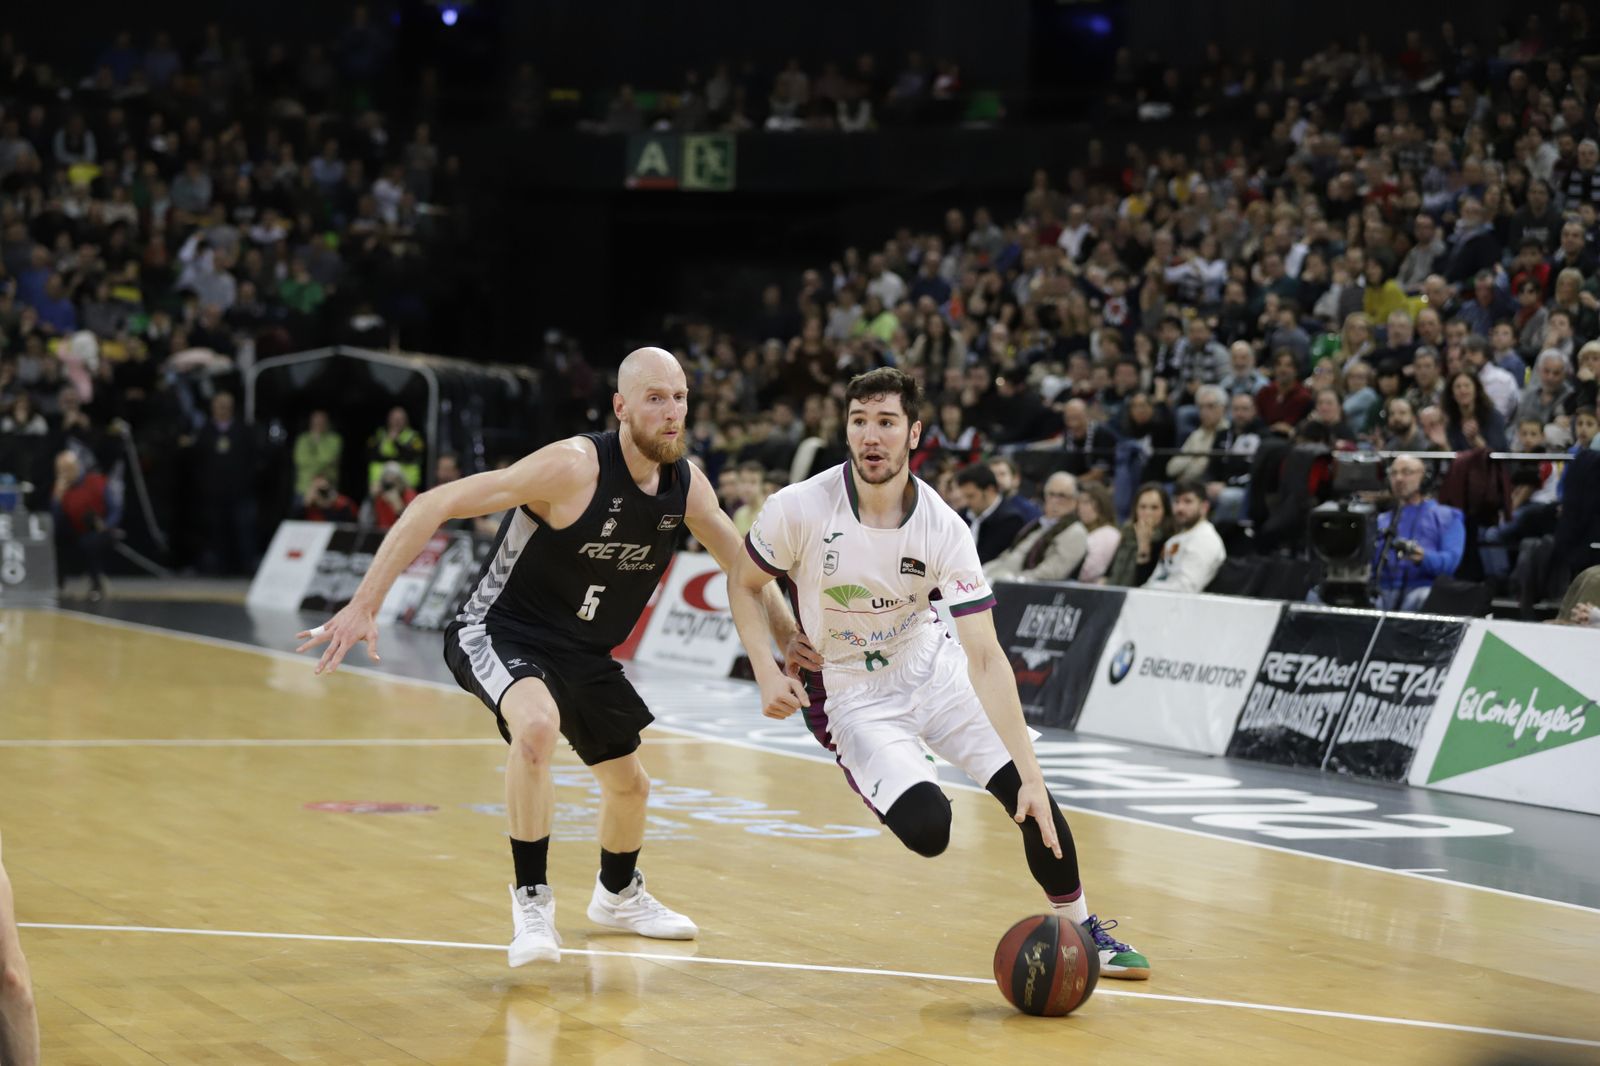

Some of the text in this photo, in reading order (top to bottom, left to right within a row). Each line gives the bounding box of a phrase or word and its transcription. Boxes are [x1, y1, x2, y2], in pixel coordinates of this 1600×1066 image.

[637, 141, 670, 176] A
[578, 542, 652, 561] RETA
[576, 584, 606, 621] 5
[1138, 656, 1248, 689] ENEKURI MOTOR
[1475, 690, 1522, 728] Corte
[1513, 687, 1586, 743] Inglés
